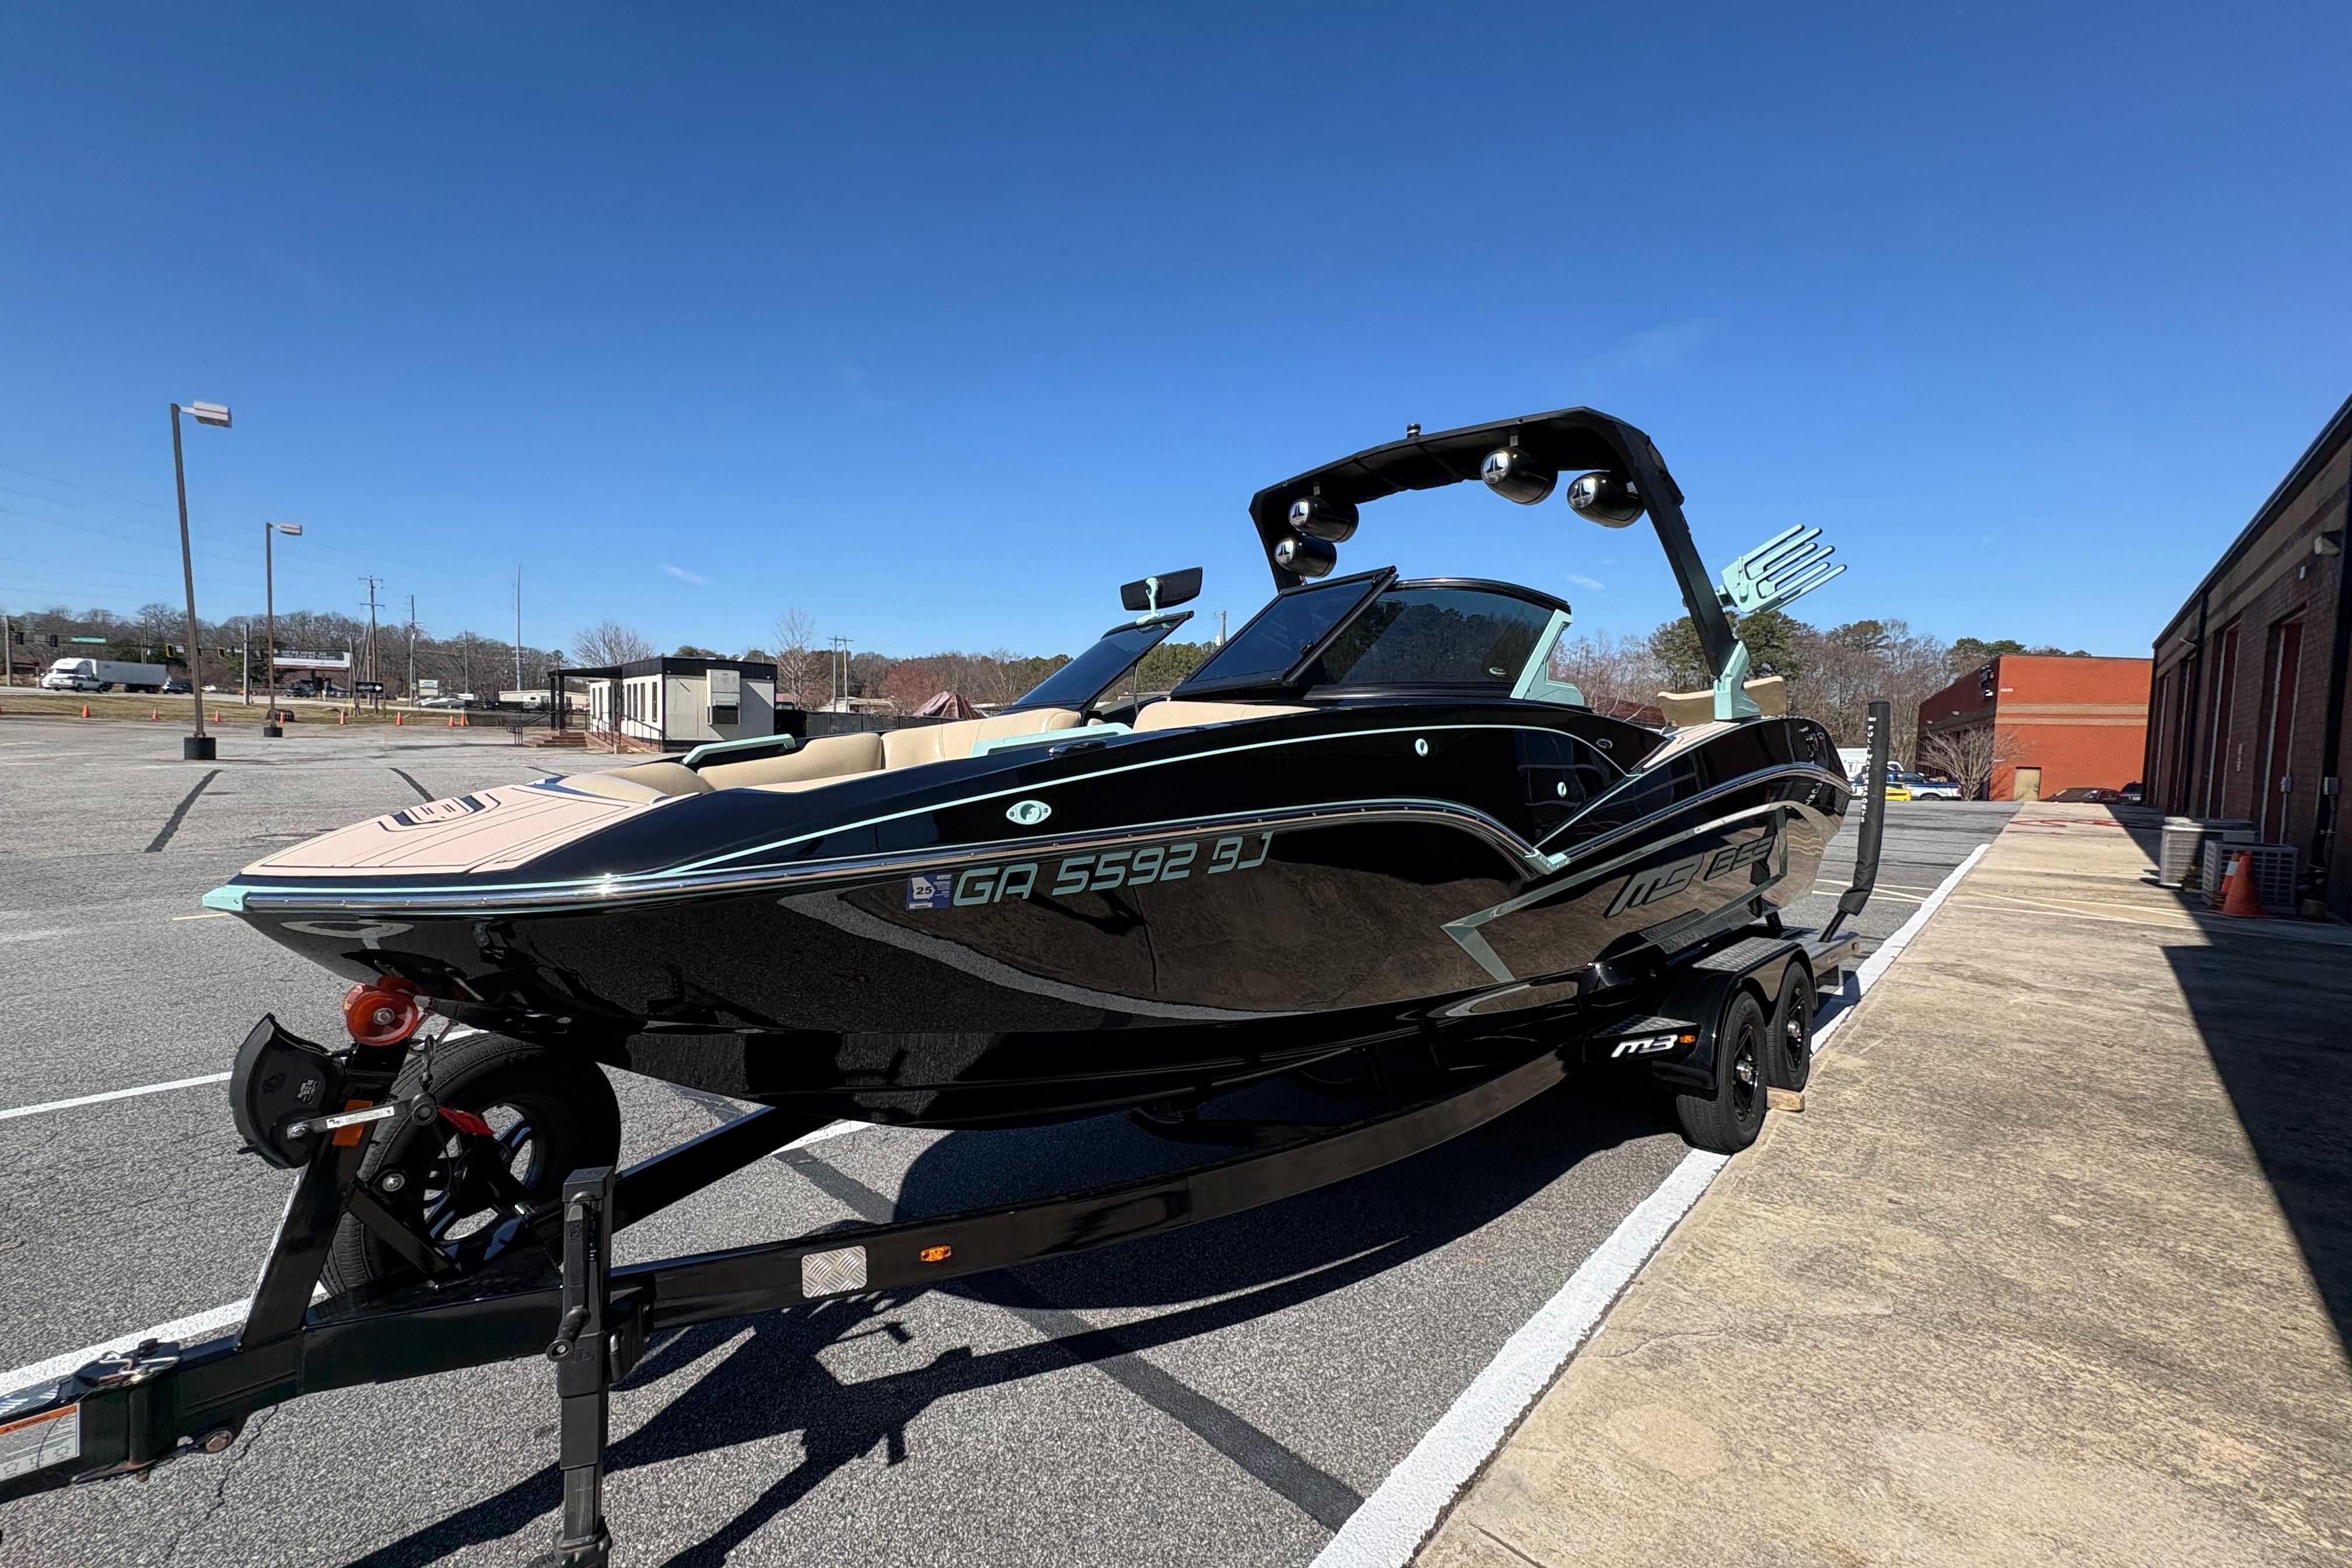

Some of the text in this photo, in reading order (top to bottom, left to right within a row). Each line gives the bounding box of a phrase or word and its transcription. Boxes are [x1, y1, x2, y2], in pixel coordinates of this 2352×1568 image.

[916, 886, 932, 895] 25
[953, 862, 1039, 907] GA
[1052, 842, 1198, 895] 5592
